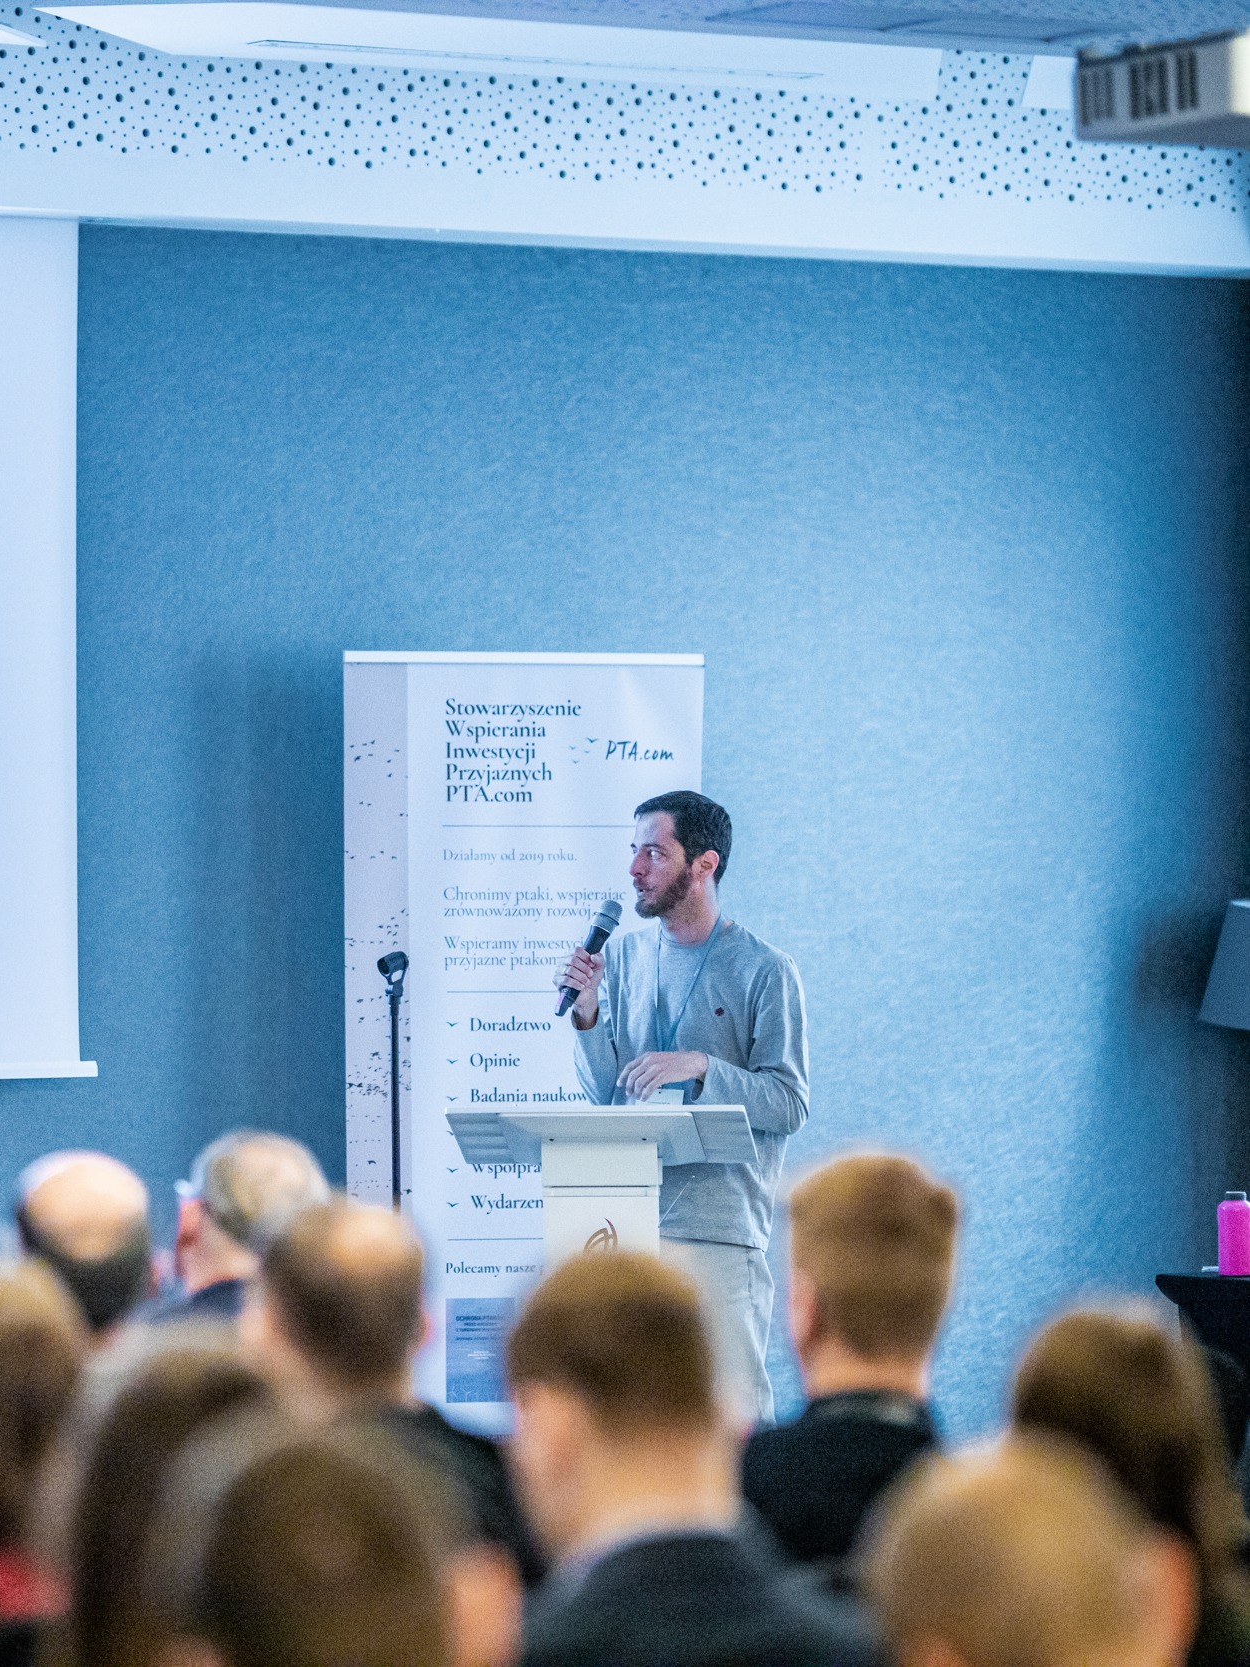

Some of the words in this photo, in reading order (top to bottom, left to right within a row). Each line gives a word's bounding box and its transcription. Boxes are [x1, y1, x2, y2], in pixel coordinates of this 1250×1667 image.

[445, 697, 582, 722] Stowarzyszenie
[445, 719, 547, 744] Wspierania
[445, 741, 536, 765] Inwestycji
[605, 739, 675, 762] PTA.com
[445, 761, 553, 788] Przyjaznych
[445, 784, 533, 803] PTA.com
[500, 848, 516, 861] od
[519, 852, 544, 865] 2019
[547, 848, 578, 861] roku.
[443, 886, 512, 904] Chronimy
[515, 885, 554, 905] ptaki,
[443, 902, 543, 922] zrównoważony
[443, 936, 520, 954] Wspieramy
[444, 954, 506, 971] przyjazne
[469, 1015, 551, 1032] Doradztwo
[469, 1052, 521, 1072] Opinie
[470, 1086, 528, 1103] Badania
[445, 1261, 502, 1278] Polecamy
[505, 1264, 537, 1273] nasze
